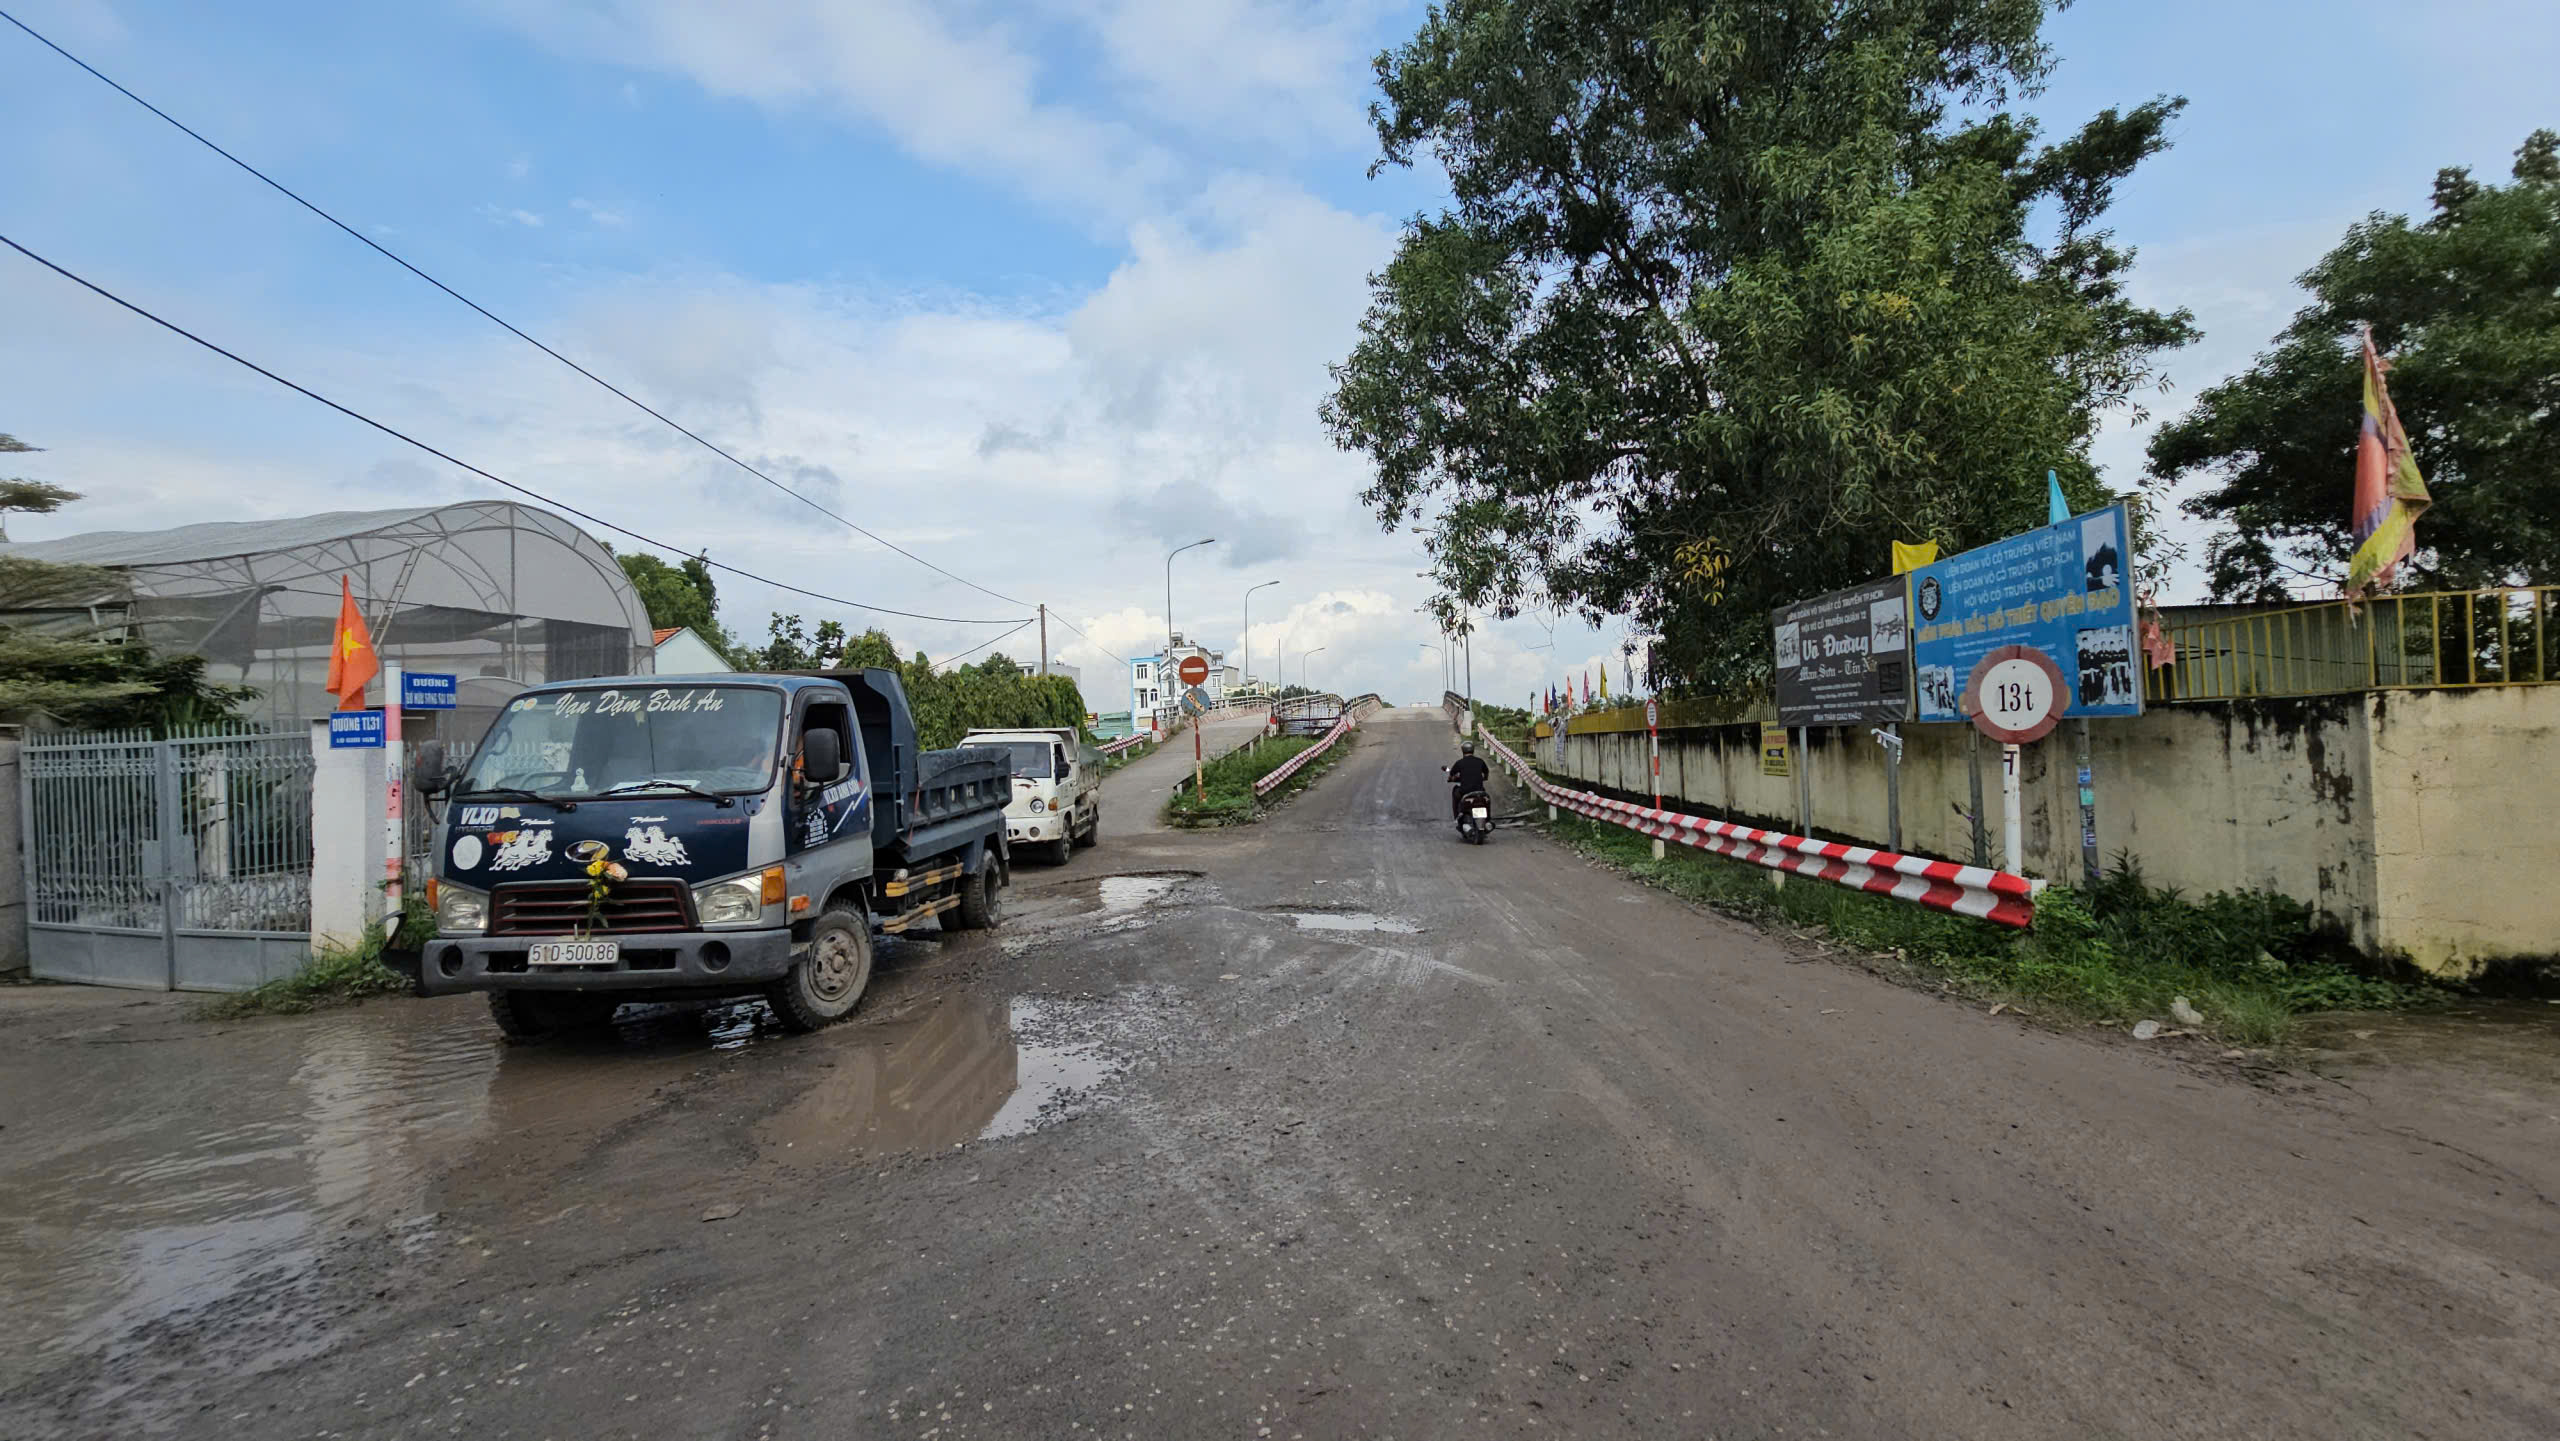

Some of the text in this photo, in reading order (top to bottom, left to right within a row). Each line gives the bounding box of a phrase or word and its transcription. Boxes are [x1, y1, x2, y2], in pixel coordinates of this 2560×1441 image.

[555, 688, 724, 719] Vạn Dặm Bình An
[361, 716, 380, 731] TL31
[461, 807, 499, 825] VLXD
